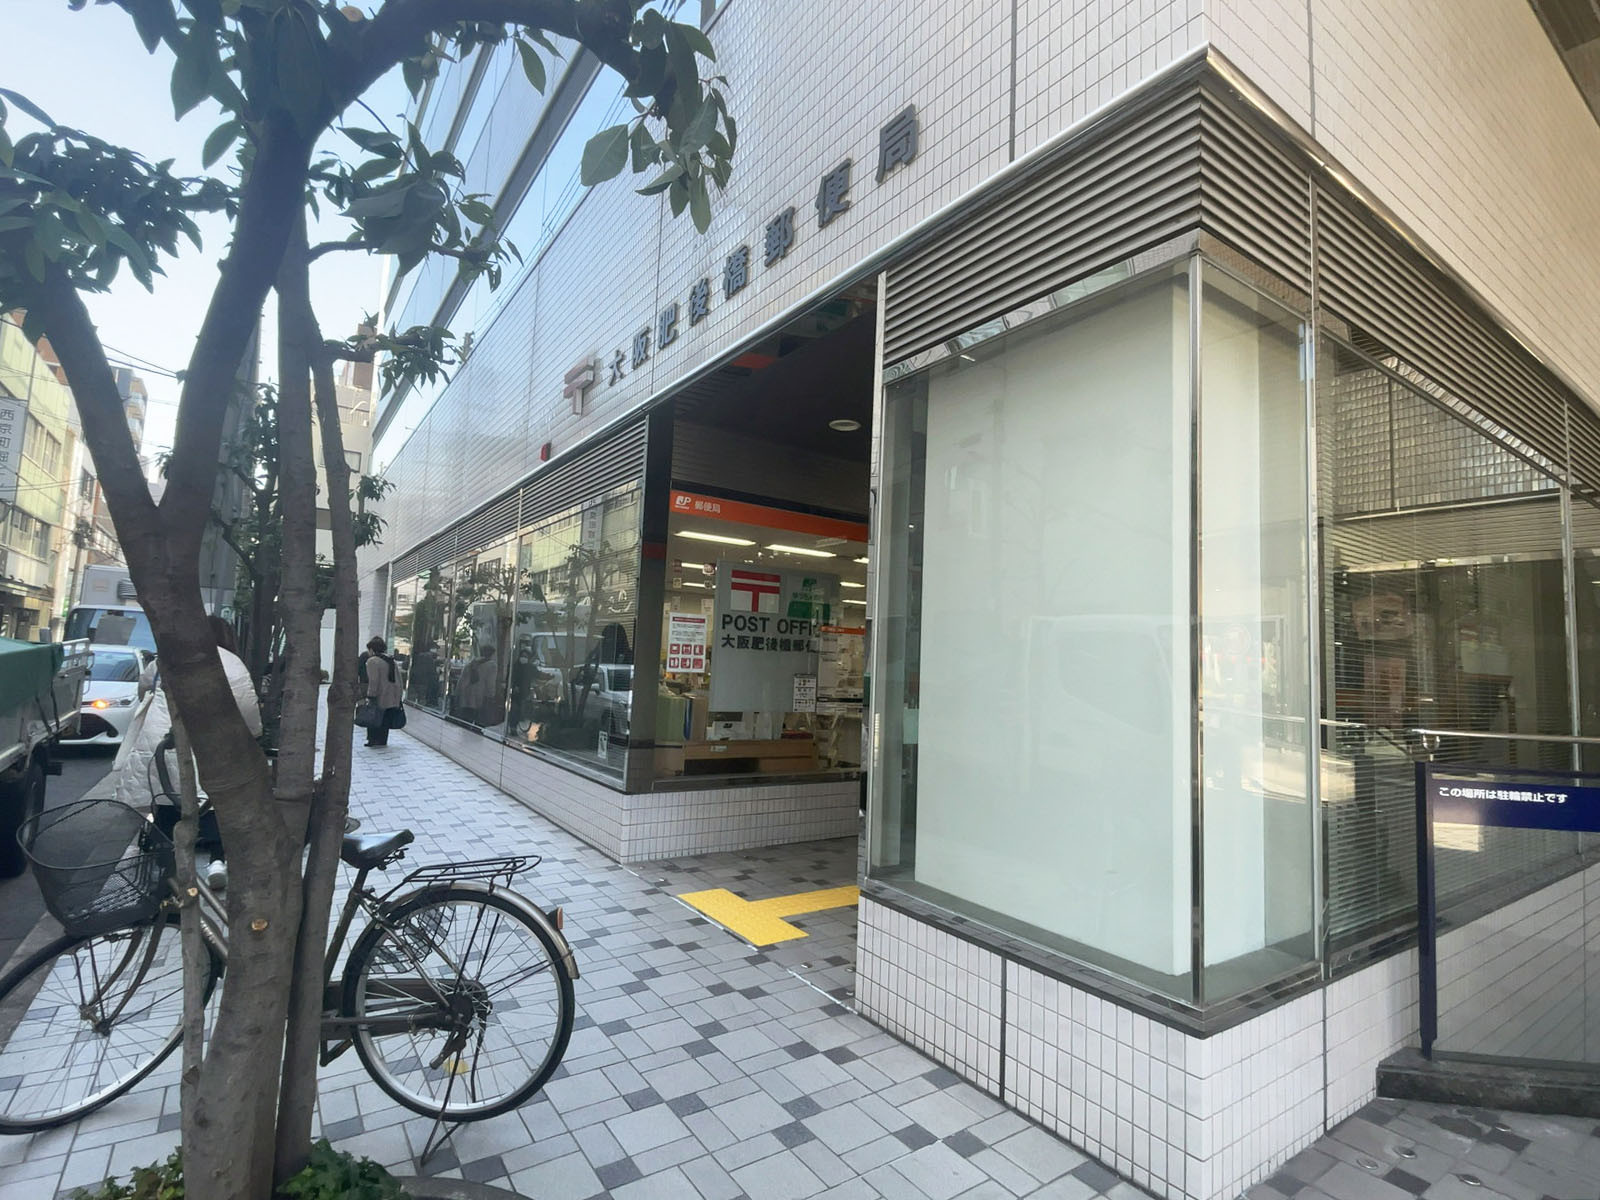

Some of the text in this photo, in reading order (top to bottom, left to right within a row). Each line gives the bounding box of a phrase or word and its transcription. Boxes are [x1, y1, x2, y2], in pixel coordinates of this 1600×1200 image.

[607, 103, 920, 386] 大阪肥後橋郵便局
[721, 614, 770, 633] POST
[776, 618, 819, 636] OFFI
[1439, 787, 1568, 804] この場所は駐輪禁止です
